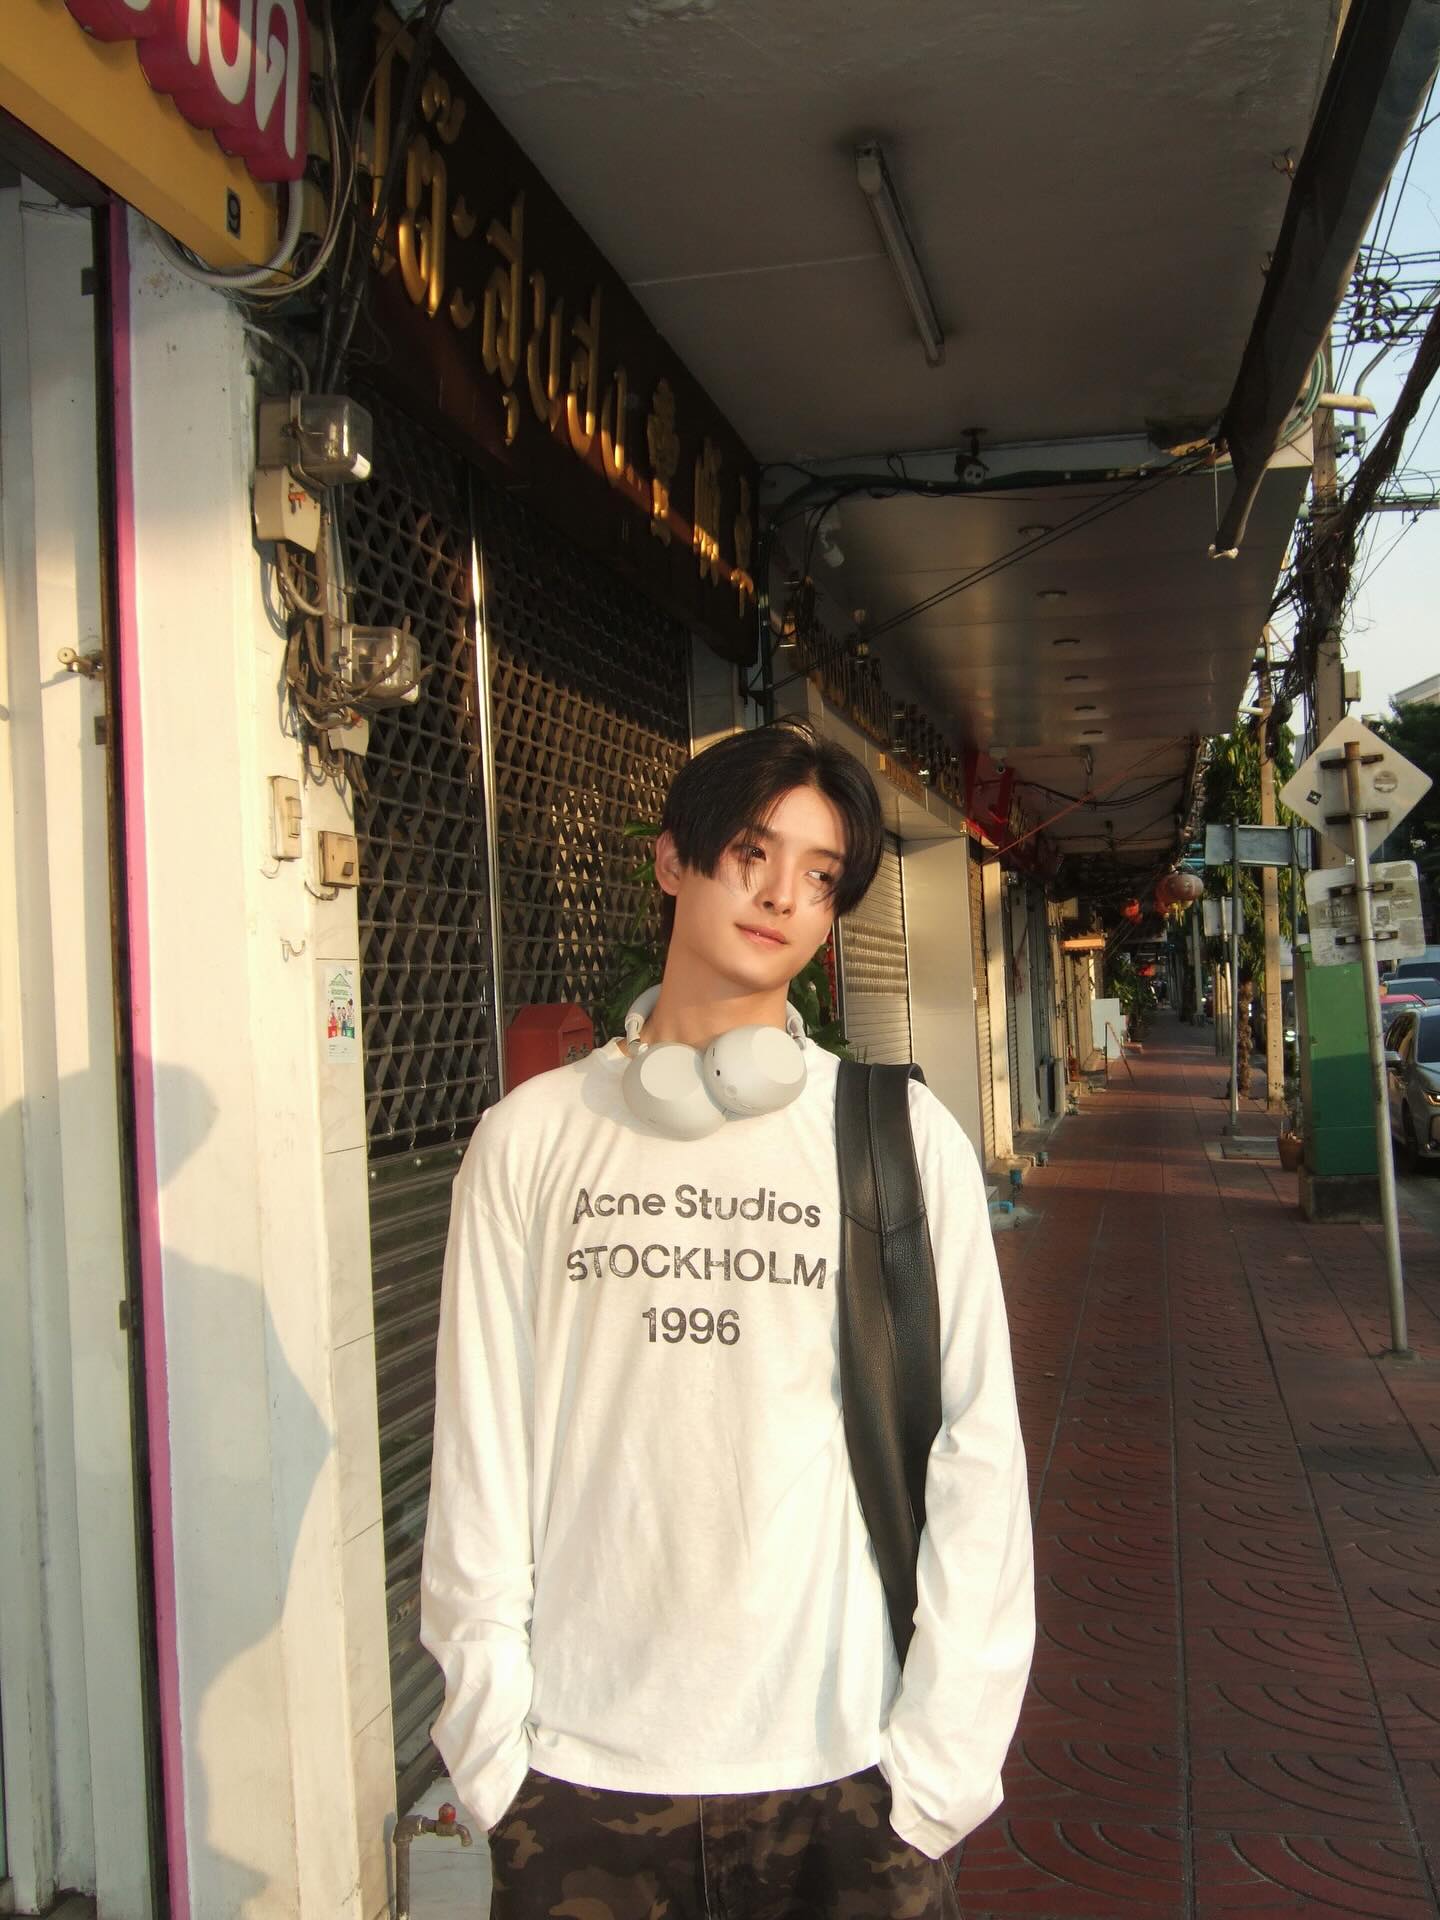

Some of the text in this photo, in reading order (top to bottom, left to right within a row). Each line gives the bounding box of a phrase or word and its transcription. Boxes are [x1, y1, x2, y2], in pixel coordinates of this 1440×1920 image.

[572, 1184, 821, 1228] Acne Studios
[566, 1243, 827, 1290] STOCKHOLM
[642, 1306, 741, 1346] 1996
